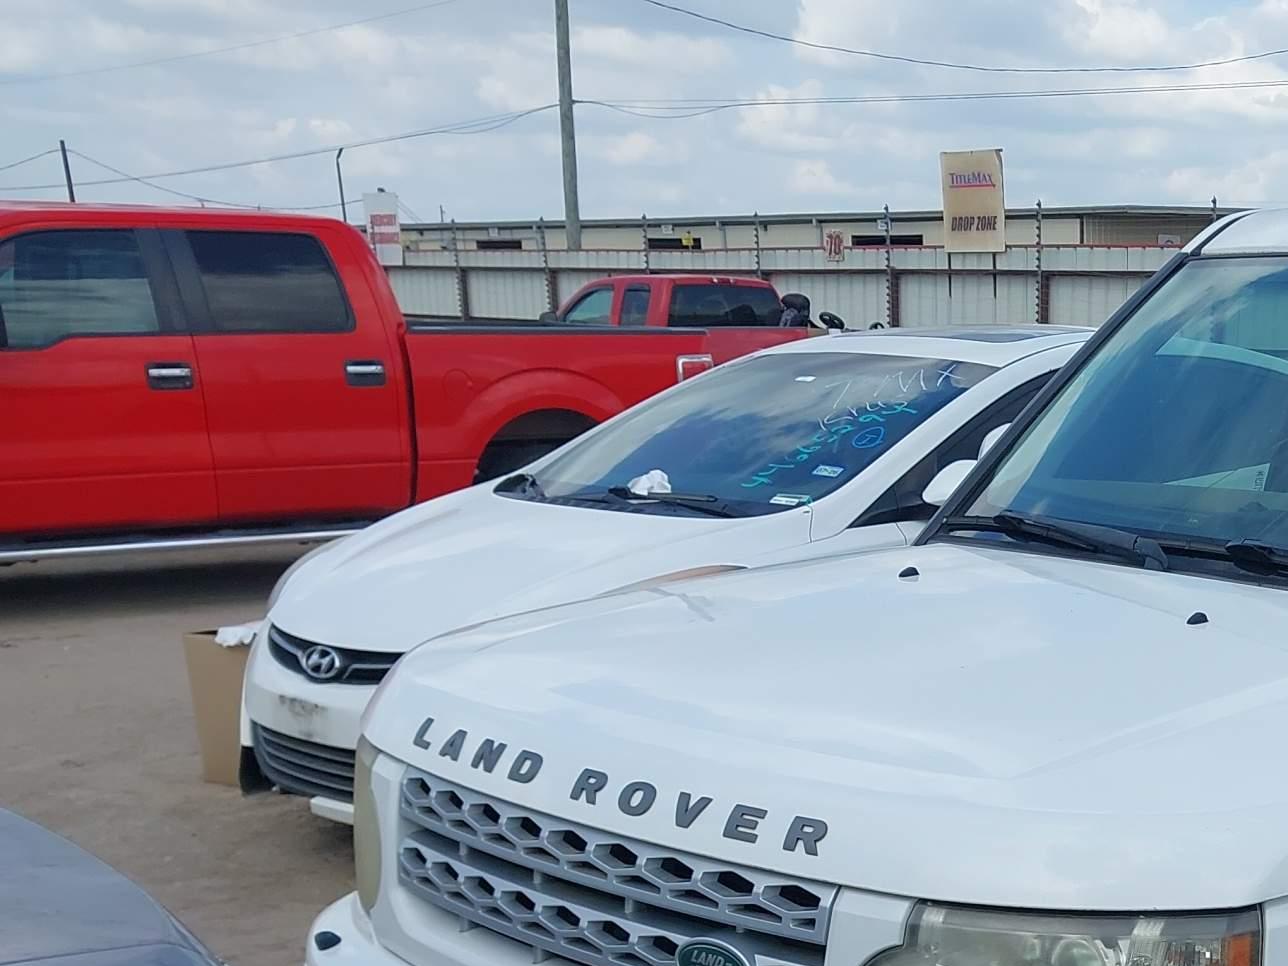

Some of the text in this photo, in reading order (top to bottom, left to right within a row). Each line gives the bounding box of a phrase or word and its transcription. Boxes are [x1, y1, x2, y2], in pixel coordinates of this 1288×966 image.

[951, 215, 998, 232] DROP ZONE
[412, 716, 830, 857] LAND ROVER
